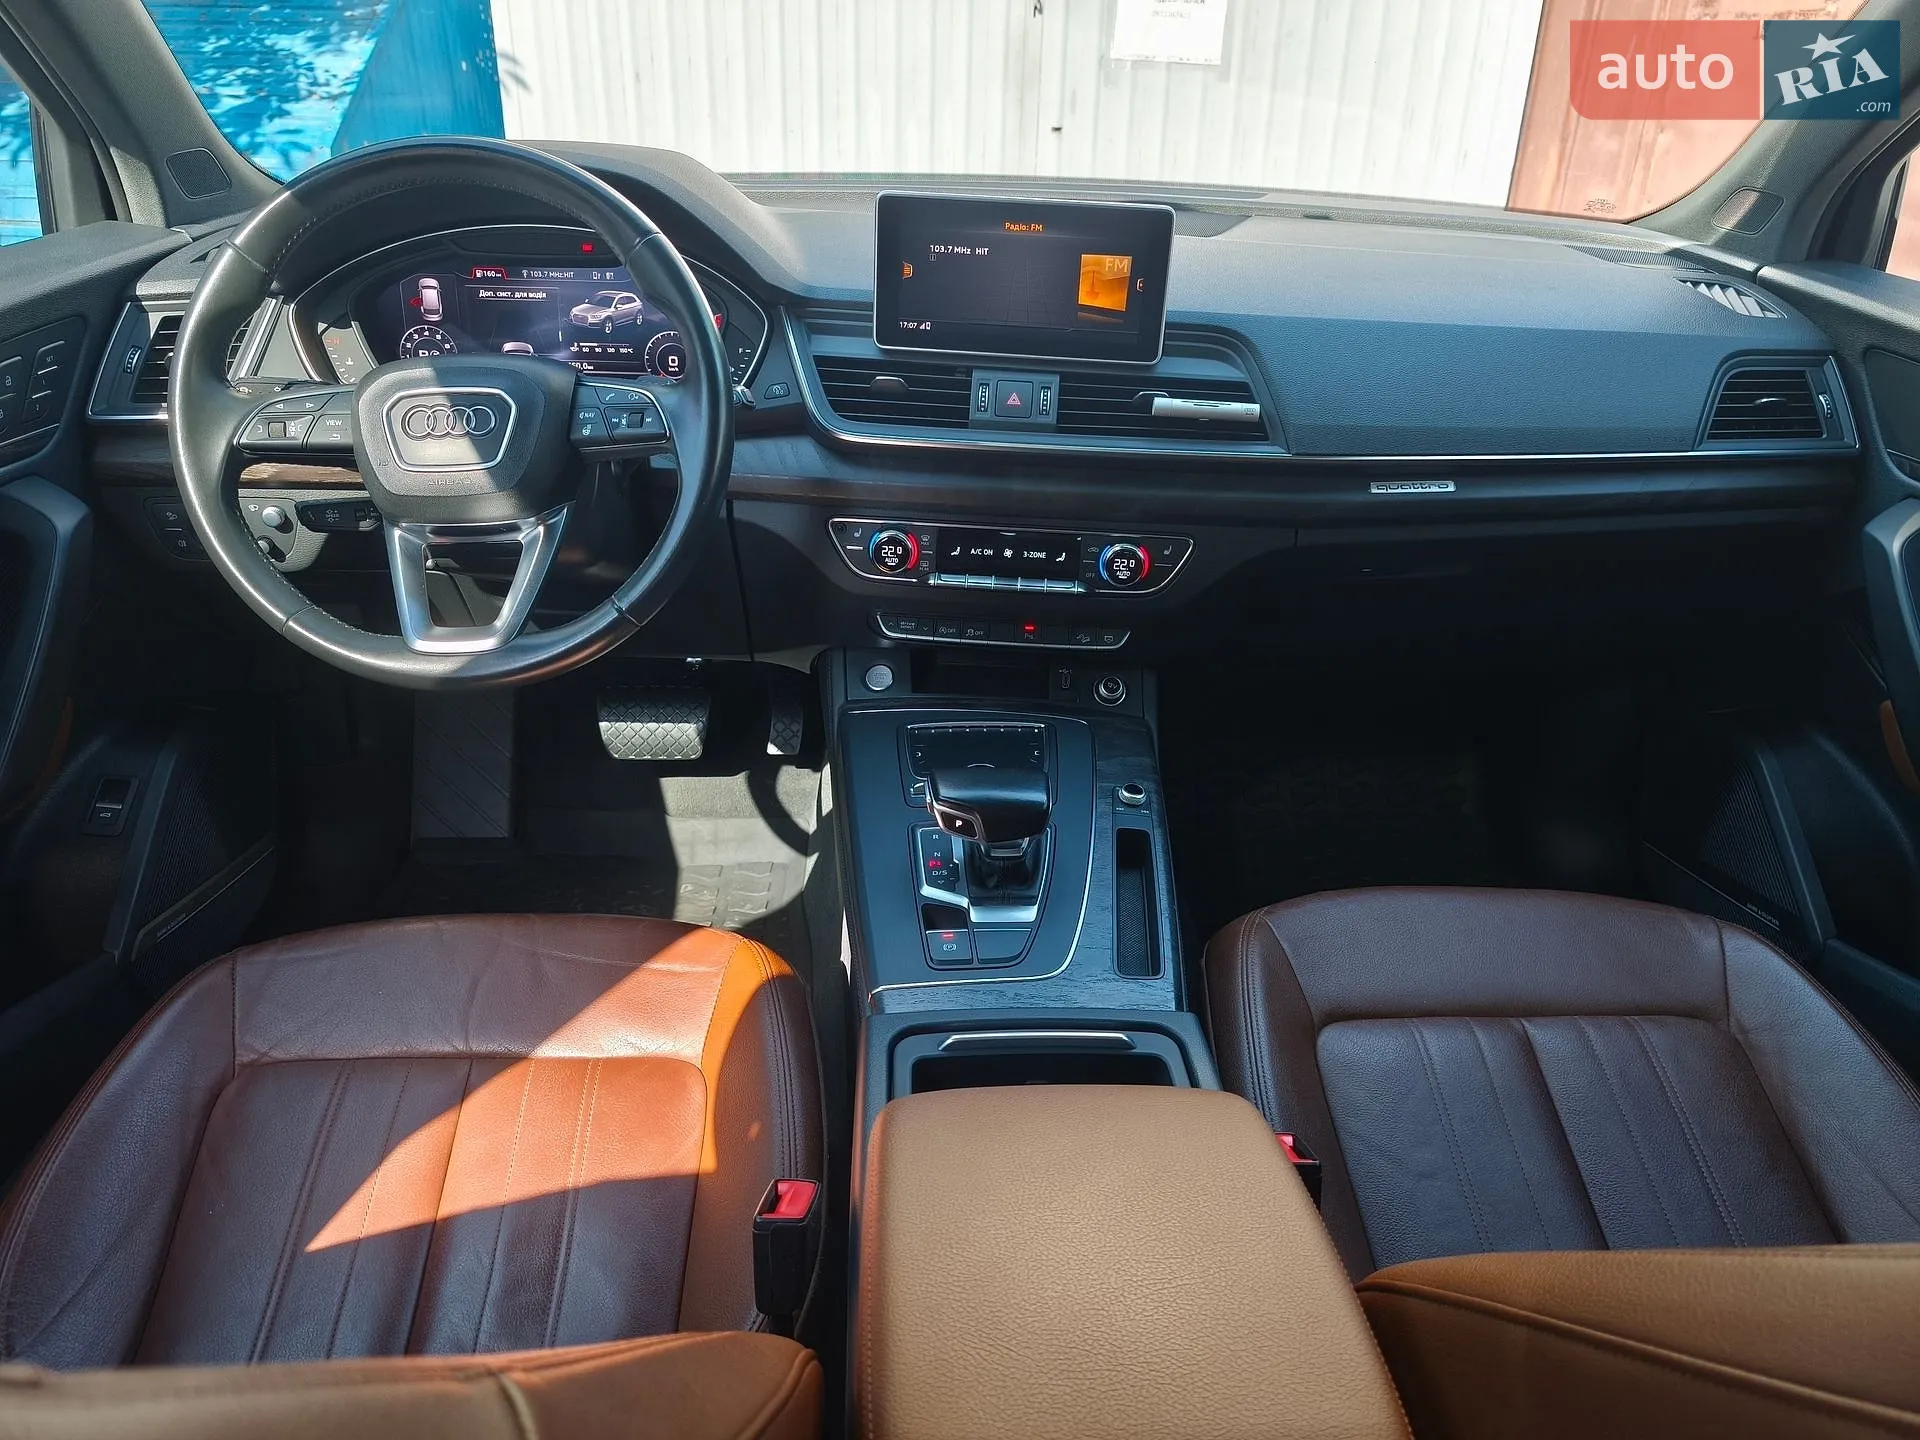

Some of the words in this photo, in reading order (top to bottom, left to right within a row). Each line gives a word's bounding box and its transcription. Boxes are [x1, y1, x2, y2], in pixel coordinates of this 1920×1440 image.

[1004, 222, 1030, 232] Радіо:
[1031, 223, 1043, 232] FM
[929, 244, 952, 254] 103.7
[954, 245, 972, 255] MHz
[975, 247, 989, 256] HIT
[1105, 257, 1129, 273] FM
[479, 289, 495, 298] Доп.
[899, 321, 918, 329] 17:07
[1376, 482, 1449, 492] quattro
[983, 548, 994, 556] ON
[1022, 551, 1047, 559] 3-ZONE
